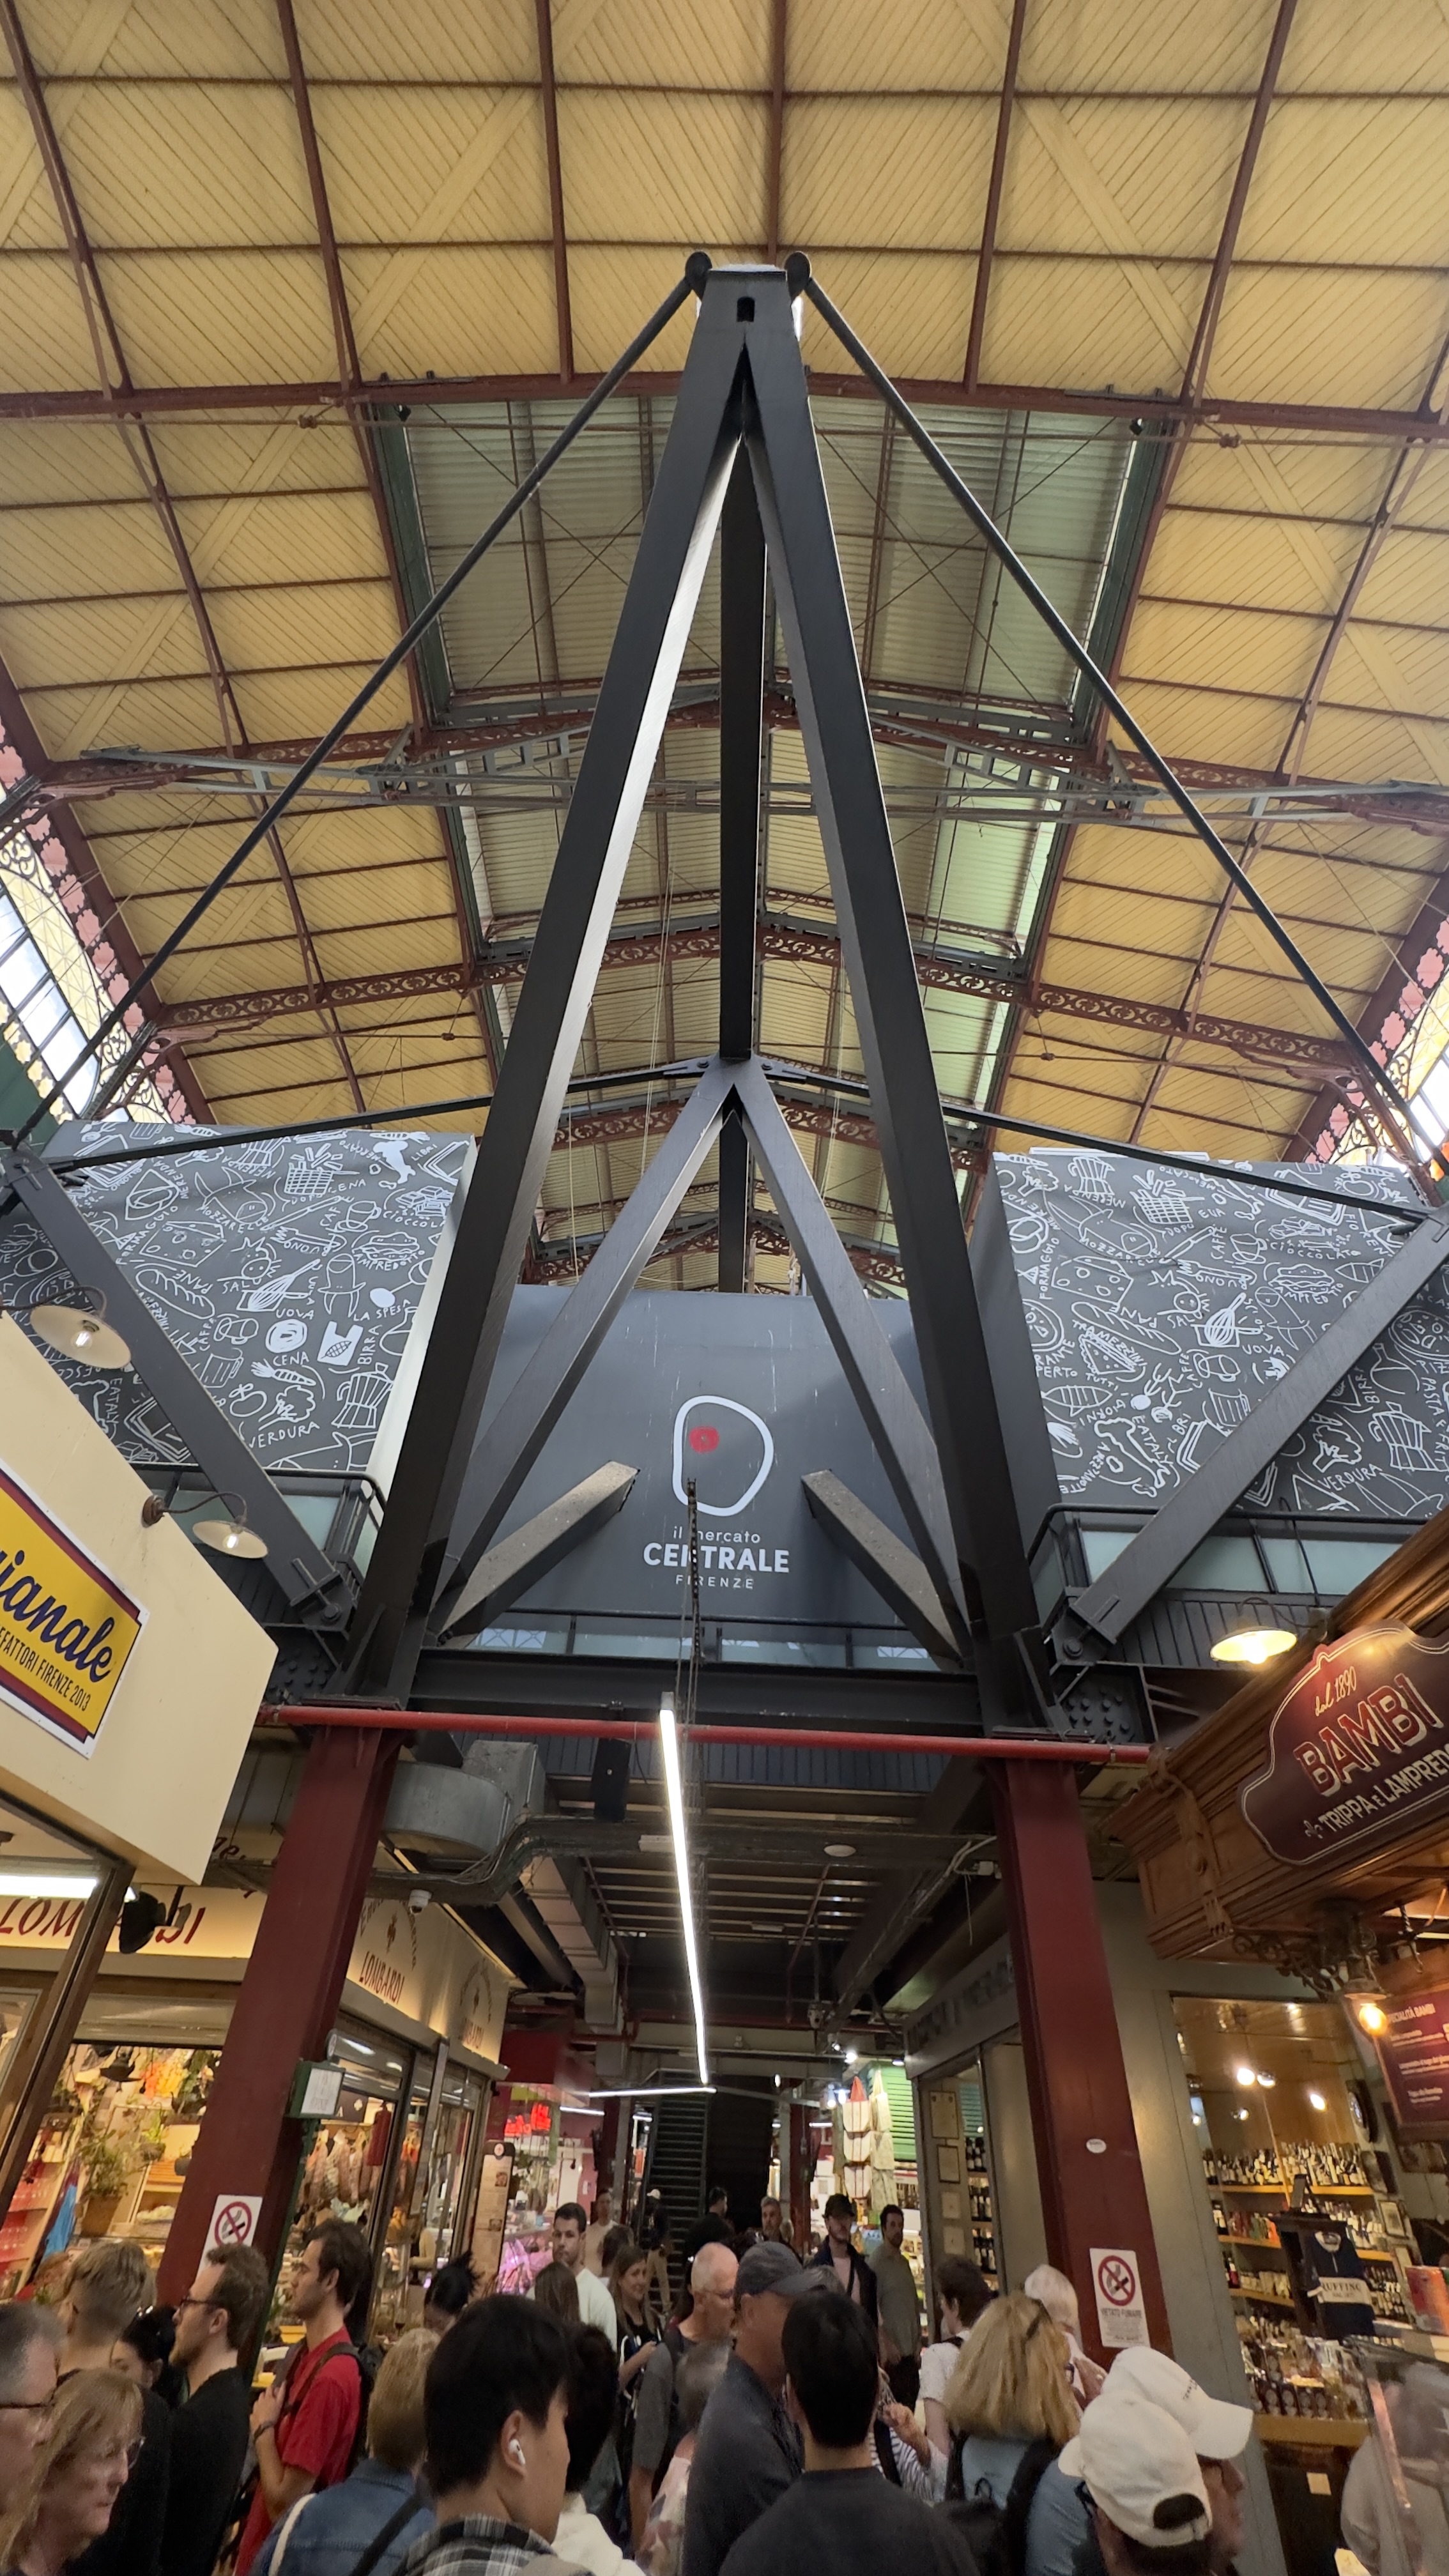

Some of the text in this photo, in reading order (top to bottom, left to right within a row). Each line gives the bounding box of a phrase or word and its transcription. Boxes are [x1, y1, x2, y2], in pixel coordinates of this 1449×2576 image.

[411, 1144, 438, 1162] LIBRI
[328, 1178, 367, 1193] CENA
[172, 1269, 214, 1294] PANE
[1038, 1237, 1060, 1300] FORMAGGIO
[275, 1309, 315, 1320] UOVA
[353, 1299, 411, 1322] LA SPESA
[357, 1324, 383, 1365] BIRRA
[1242, 1344, 1285, 1356] UOVA
[272, 1351, 310, 1367] CENA
[1085, 1372, 1119, 1392] TUTTI
[104, 1377, 123, 1425] EATALY
[1421, 1377, 1445, 1416] PASTA
[249, 1421, 320, 1449] VERDURA
[1131, 1414, 1174, 1465] EATALY
[1317, 1463, 1383, 1491] VERDURA
[673, 1526, 683, 1539] il
[643, 1542, 790, 1573] CENTRALE
[36, 1659, 73, 1698] FIRENZE
[69, 1684, 91, 1712] 2013
[1315, 1666, 1357, 1717] dal 1890
[1292, 1672, 1445, 1797] BAMBI
[1317, 1795, 1379, 1832] TRIPPA
[358, 1951, 405, 2005] LOMBARDI
[1100, 2307, 1143, 2319] VIETATO FUMARE
